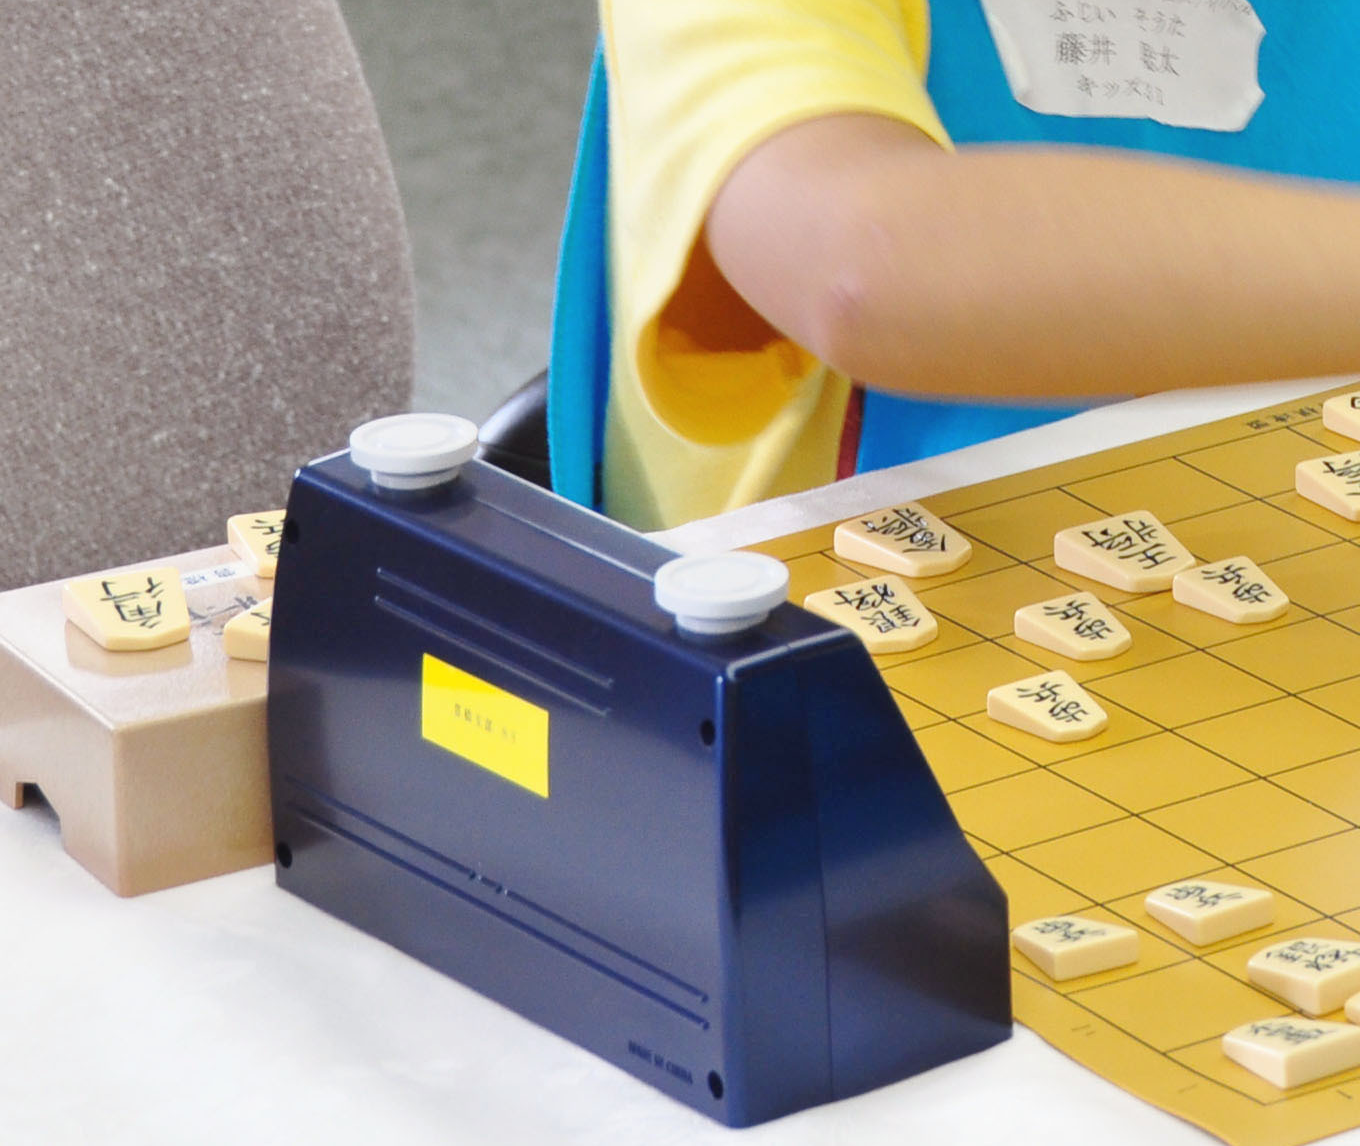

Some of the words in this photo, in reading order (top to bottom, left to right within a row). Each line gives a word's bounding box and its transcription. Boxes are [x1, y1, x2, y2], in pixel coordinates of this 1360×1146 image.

[1052, 1, 1117, 23] ふじい
[1057, 31, 1117, 66] 藤井
[100, 576, 167, 629] 角行
[1200, 563, 1272, 605] 歩兵
[1043, 599, 1114, 641] 歩兵
[1017, 681, 1089, 723] 歩兵
